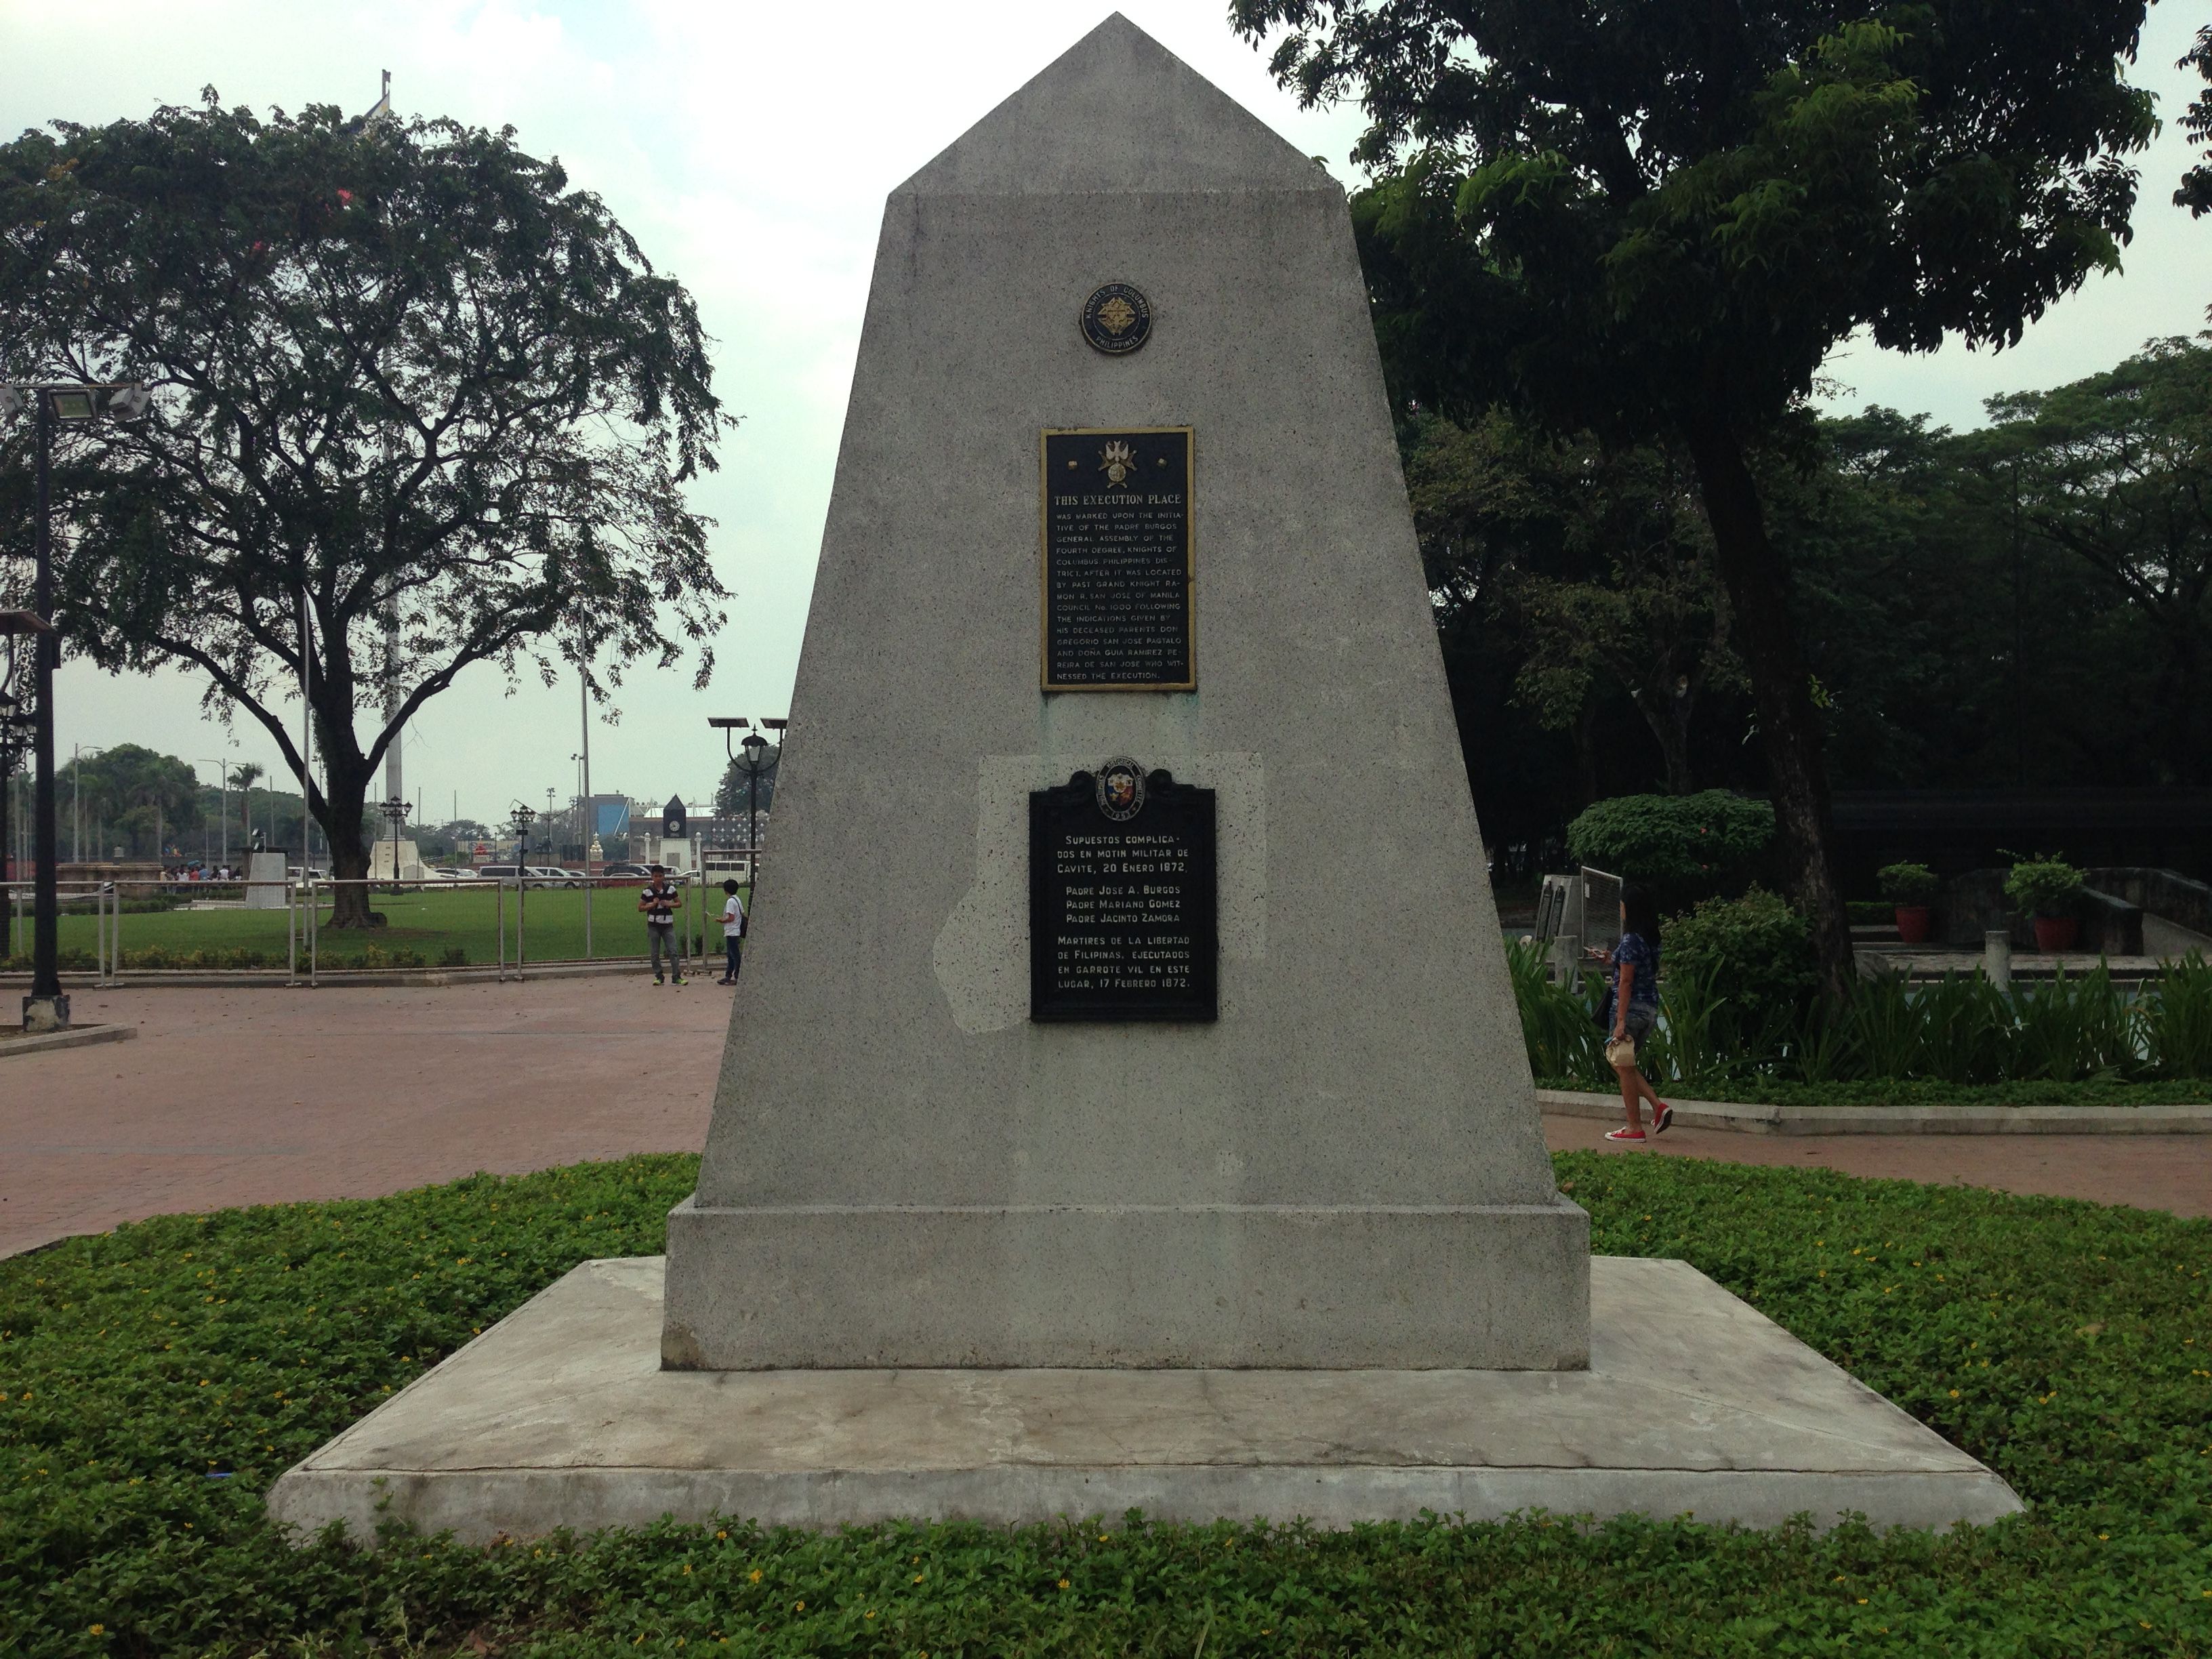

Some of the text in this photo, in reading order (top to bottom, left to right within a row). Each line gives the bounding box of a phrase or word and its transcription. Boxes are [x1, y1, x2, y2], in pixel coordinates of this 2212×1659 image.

[1086, 290, 1106, 319] KNIGHTS
[1123, 287, 1148, 319] COLUMBUS
[1096, 335, 1139, 349] PHILIPPINES
[1054, 495, 1181, 505] THIS EXECUTION PLACE
[1066, 836, 1120, 844] SUPUESTOS
[1058, 864, 1097, 874] CAVITE,
[1103, 863, 1116, 872] 20
[1123, 863, 1153, 872] ENERO
[1067, 885, 1180, 895] PADRE JOSE A. BURGOS
[1067, 899, 1180, 909] PADRE MARIANO GOMEZ
[1101, 914, 1137, 923] JACINTO
[1142, 914, 1180, 922] ZAMORA
[1058, 936, 1189, 945] MARTIRES DE LA LIBERTAD
[1058, 951, 1068, 960] DE
[1132, 951, 1189, 959] EJECUTADOS
[1059, 979, 1190, 989] LUGAR, 17 FEBRERO 1872.
